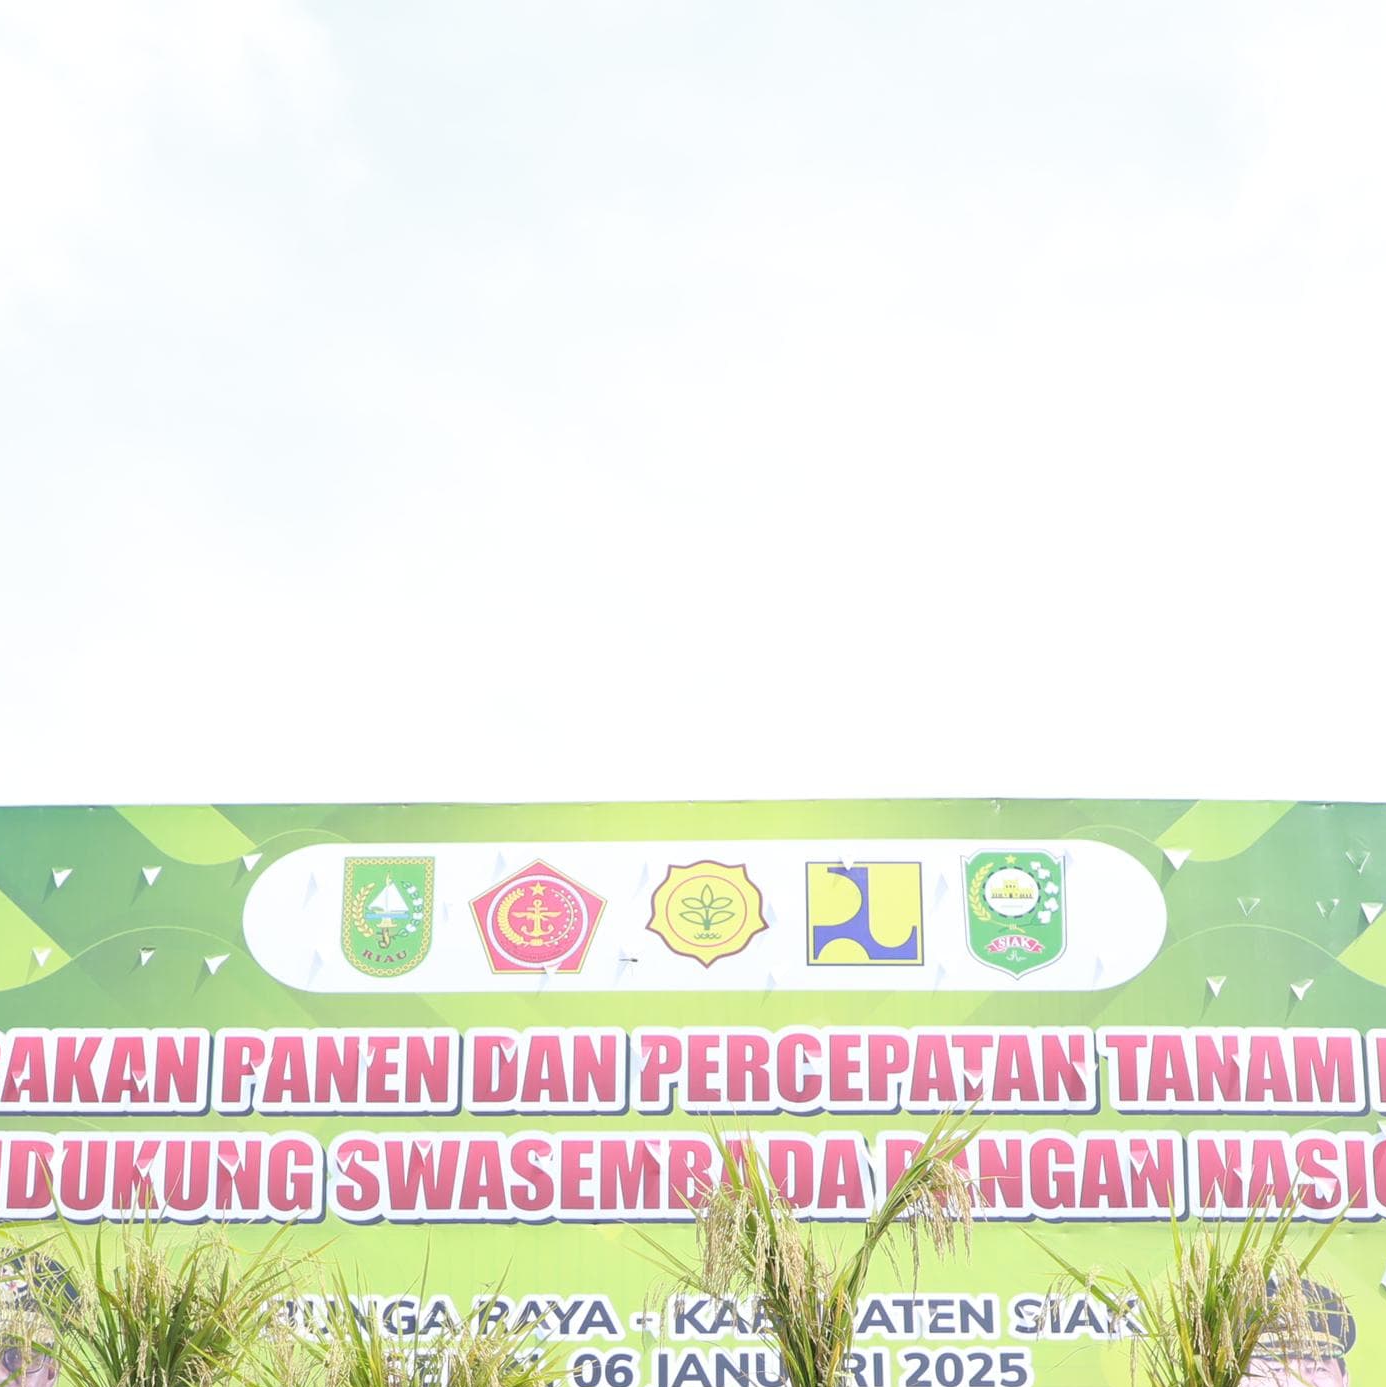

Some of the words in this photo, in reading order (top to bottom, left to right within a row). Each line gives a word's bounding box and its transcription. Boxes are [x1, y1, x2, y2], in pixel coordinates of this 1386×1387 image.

[997, 936, 1031, 950] SIAK
[362, 949, 407, 963] RIAU
[219, 1032, 452, 1106] PANEN
[471, 1032, 619, 1105] DAN
[638, 1030, 1088, 1106] PERCEPATAN
[1103, 1032, 1358, 1105] TANAM
[478, 1299, 618, 1336] RAYA
